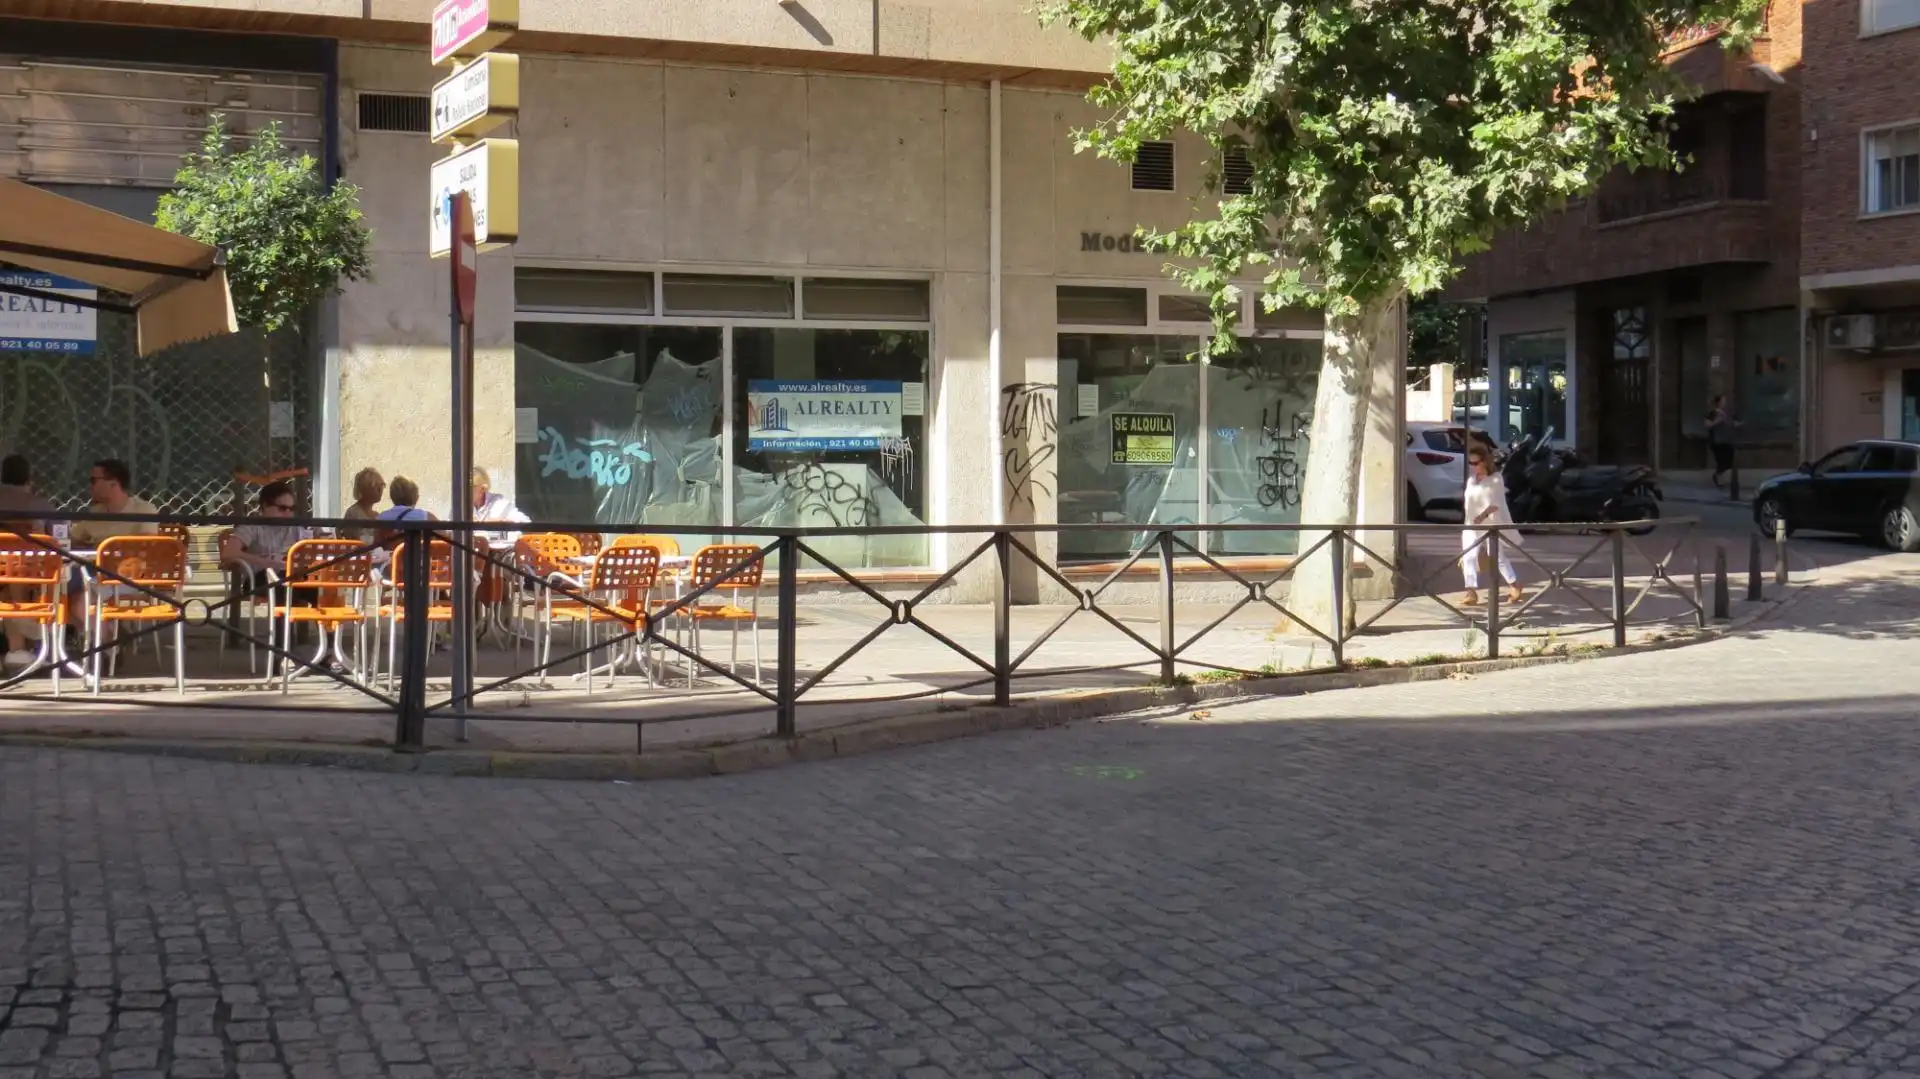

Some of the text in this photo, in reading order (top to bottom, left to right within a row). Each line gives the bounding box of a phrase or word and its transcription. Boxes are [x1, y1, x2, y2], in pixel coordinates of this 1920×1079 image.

[27, 341, 41, 349] 40
[778, 382, 867, 393] www.alrealty.es
[794, 400, 894, 416] ALREALTY
[1114, 416, 1173, 432] SE ALQUILA
[829, 439, 846, 448] 921
